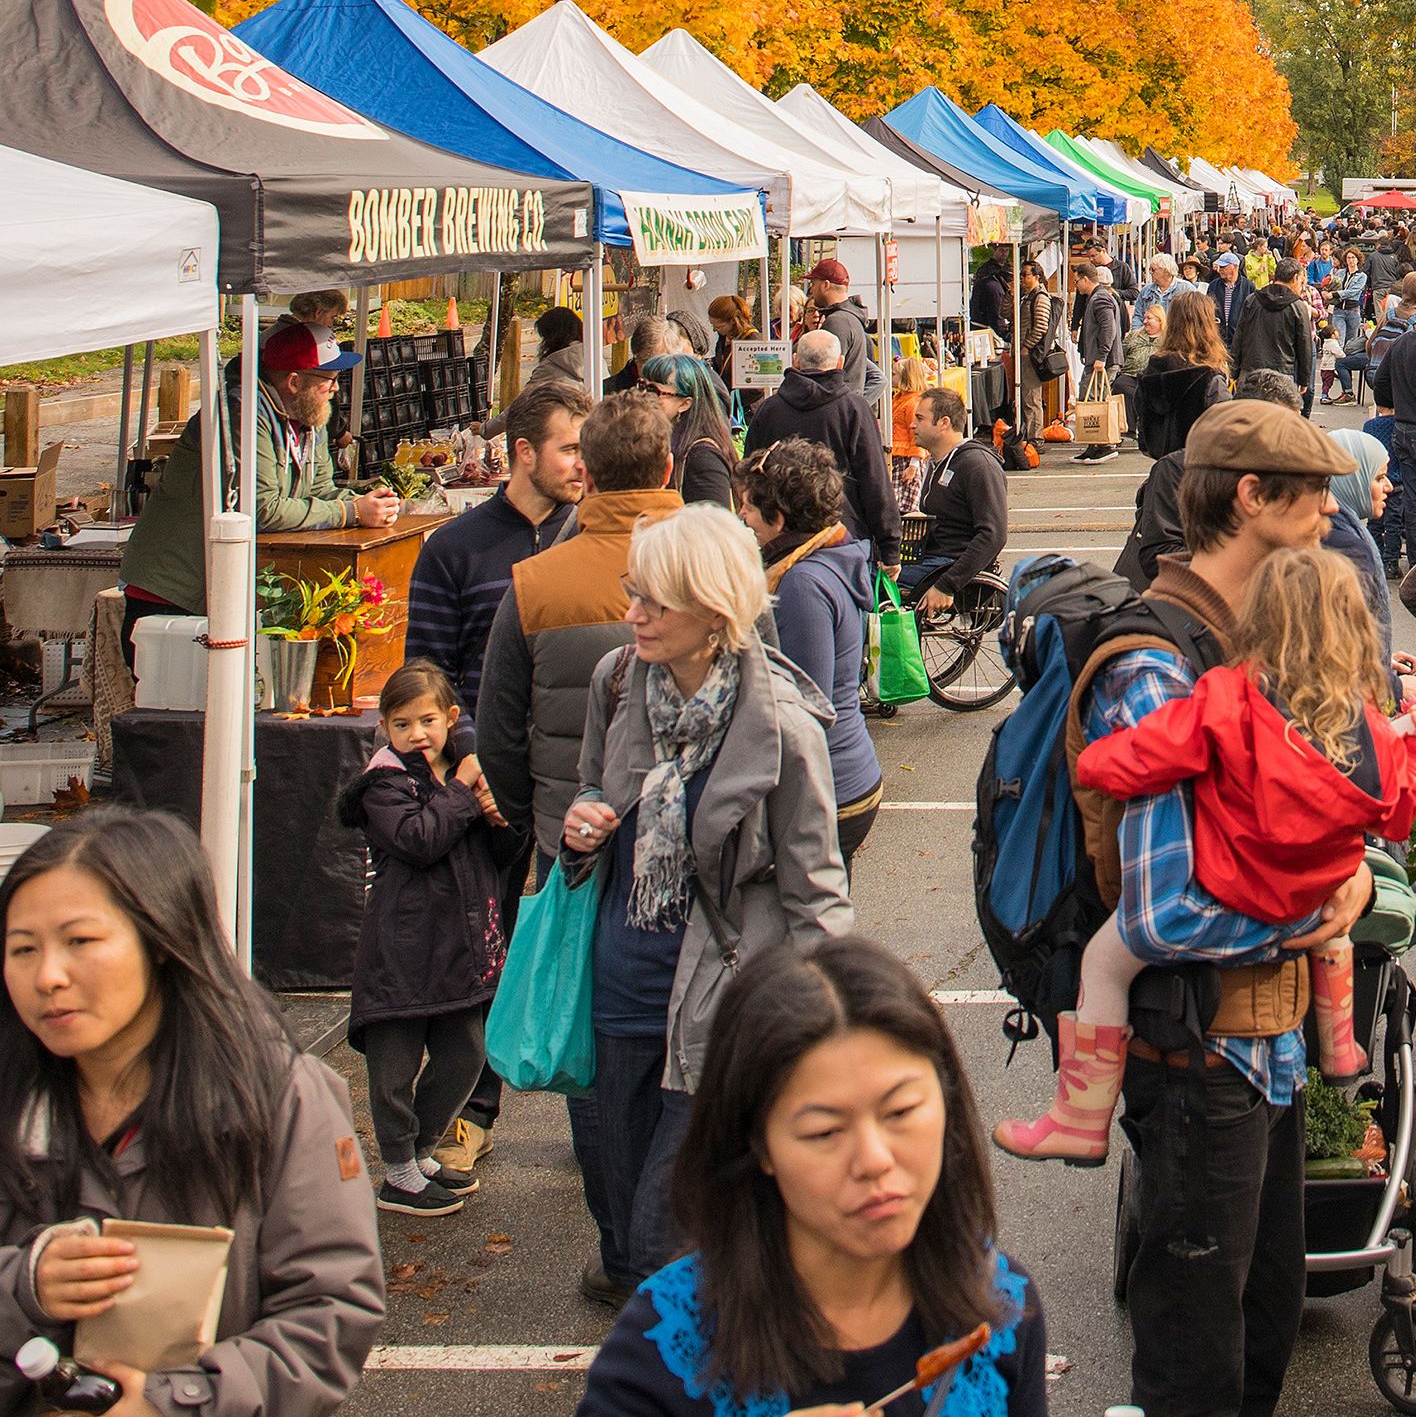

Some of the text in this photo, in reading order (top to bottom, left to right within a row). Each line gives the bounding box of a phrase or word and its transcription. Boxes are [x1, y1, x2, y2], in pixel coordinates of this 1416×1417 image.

[349, 187, 549, 263] BOMBER BREWING CO.
